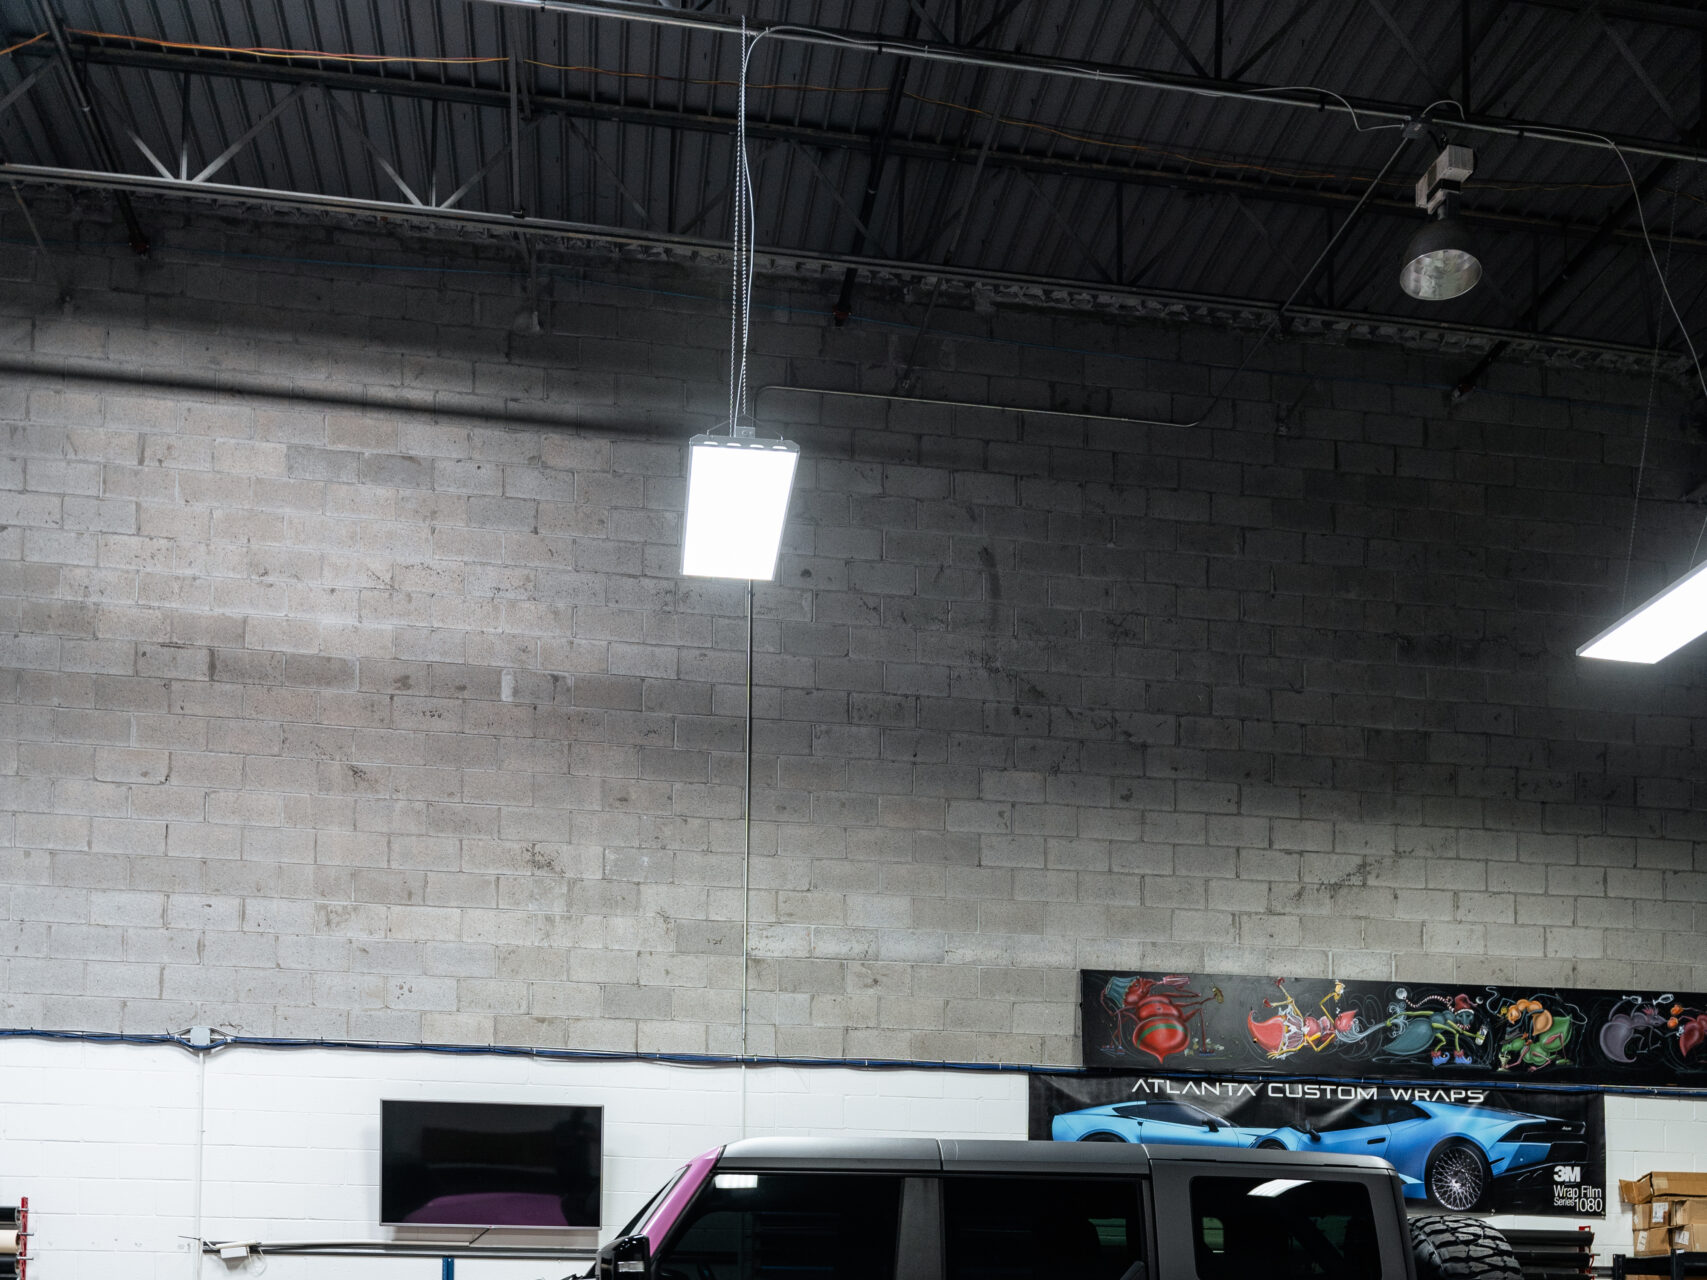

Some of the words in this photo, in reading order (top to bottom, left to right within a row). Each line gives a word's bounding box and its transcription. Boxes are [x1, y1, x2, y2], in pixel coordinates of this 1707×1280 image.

[1131, 1078, 1256, 1097] ATLANTA
[1267, 1083, 1378, 1100] CUSTOM
[1390, 1087, 1485, 1103] WRAPS
[1553, 1165, 1581, 1182] 3M
[1553, 1184, 1579, 1200] Wrap
[1581, 1185, 1602, 1198] Film
[1553, 1196, 1575, 1207] Series
[1575, 1198, 1603, 1212] 1080
